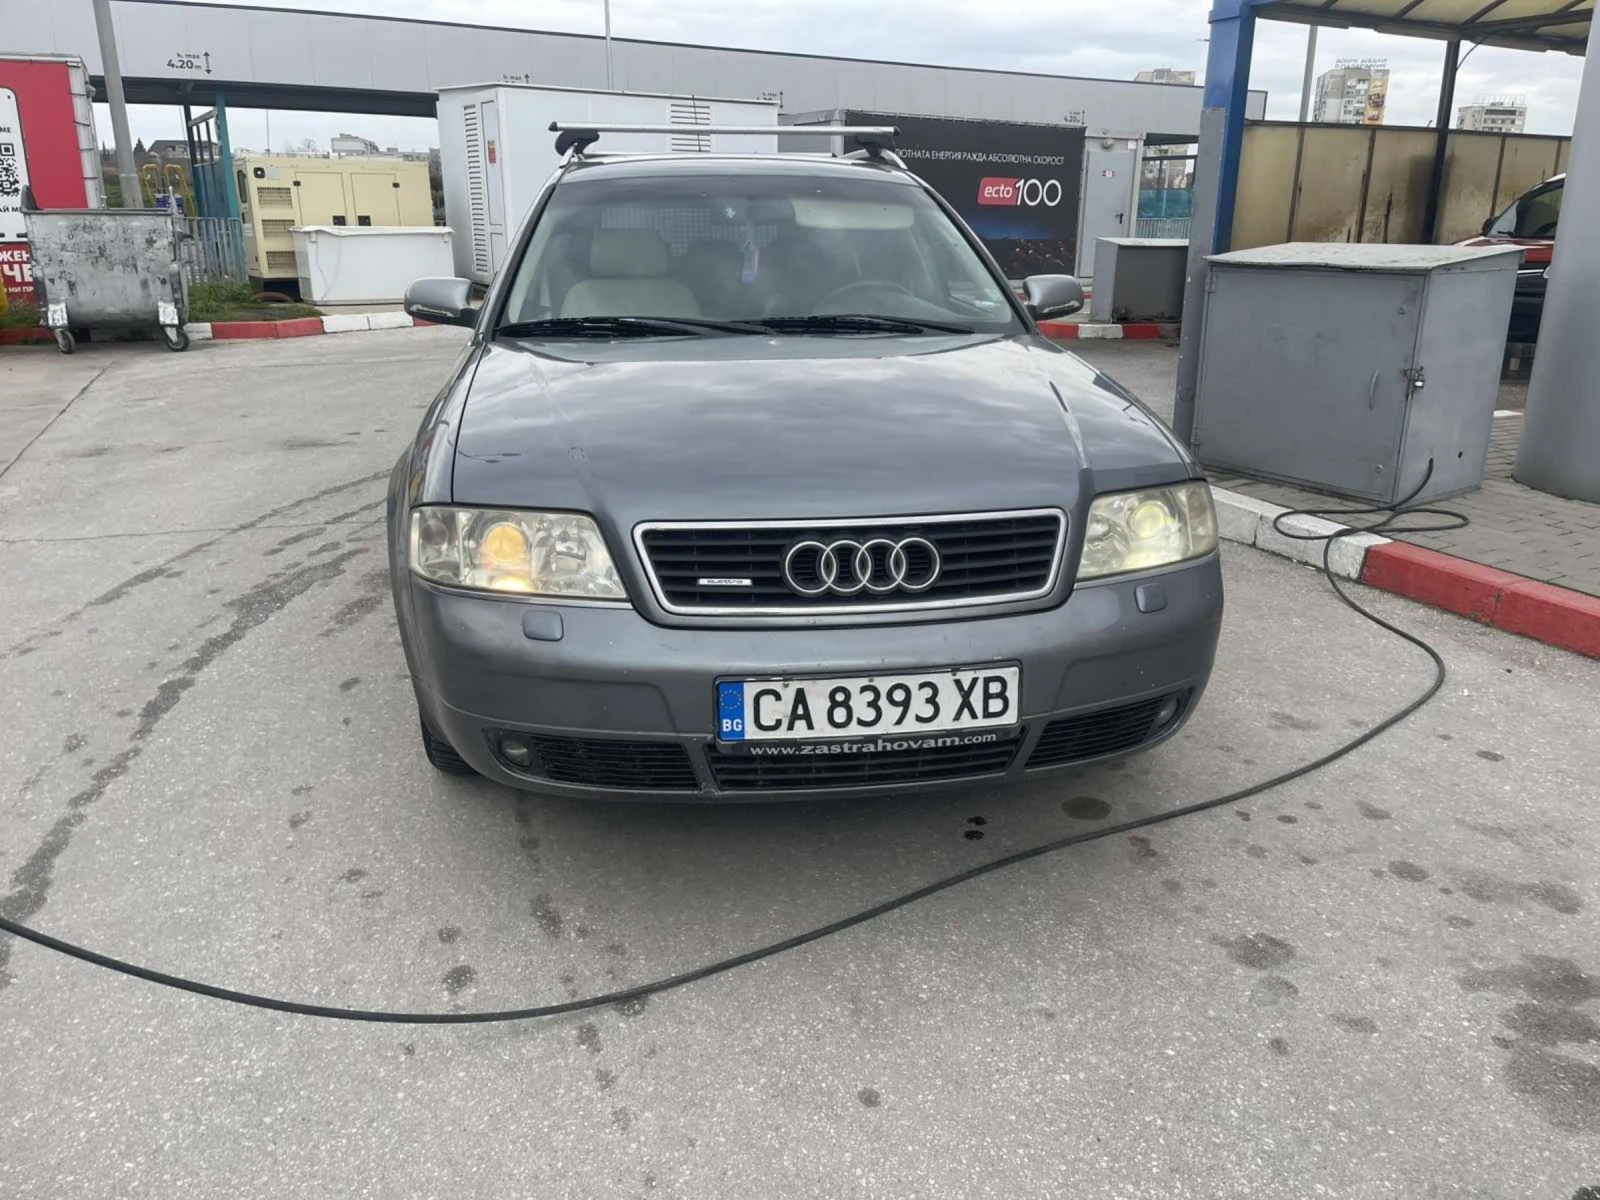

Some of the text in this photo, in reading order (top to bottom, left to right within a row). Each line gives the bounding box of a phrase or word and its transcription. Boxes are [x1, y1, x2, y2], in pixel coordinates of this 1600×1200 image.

[931, 150, 961, 161] ЕНЕРГИЯ
[962, 152, 987, 163] РАЖДА
[988, 153, 1032, 164] АБСОЛЮТНА
[1033, 155, 1064, 166] СКОРОСТ
[753, 675, 1010, 731] CA 8393 XB
[722, 719, 743, 732] BG
[750, 732, 997, 755] www.zastrahovam.com
